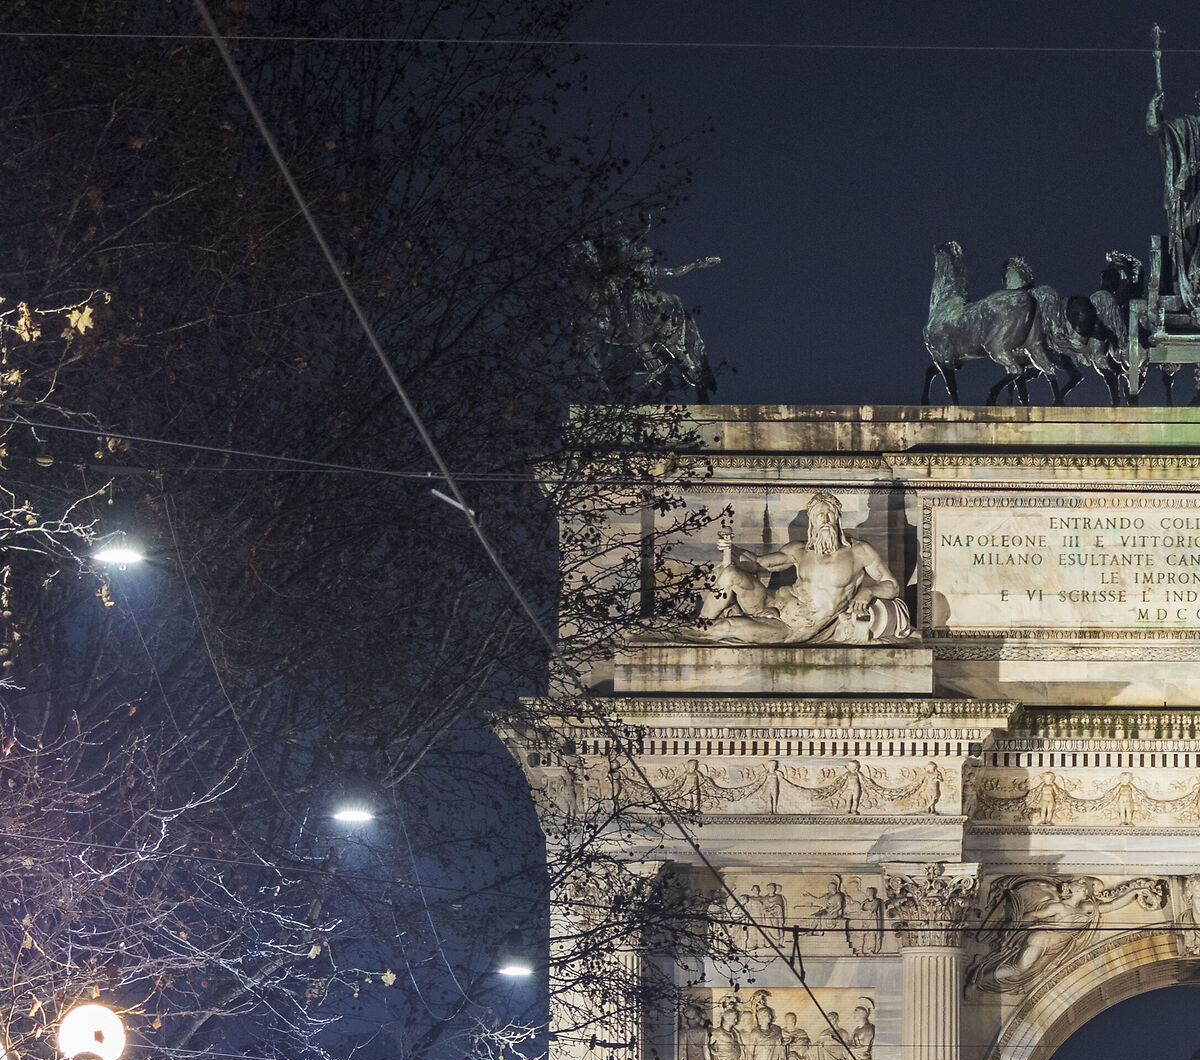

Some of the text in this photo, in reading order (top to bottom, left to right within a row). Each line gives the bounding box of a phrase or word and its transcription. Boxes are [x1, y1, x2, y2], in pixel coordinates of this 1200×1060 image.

[1049, 517, 1145, 530] ENTRANDO
[940, 535, 1047, 548] NAPOLEONE
[1062, 535, 1080, 548] III
[1095, 535, 1104, 548] E
[972, 553, 1043, 566] MILANO
[1058, 553, 1154, 567] ESULTANTE
[1100, 571, 1120, 585] LE
[1000, 589, 1009, 602] E
[1027, 589, 1044, 602] VI
[1058, 589, 1127, 603] SCRISSE
